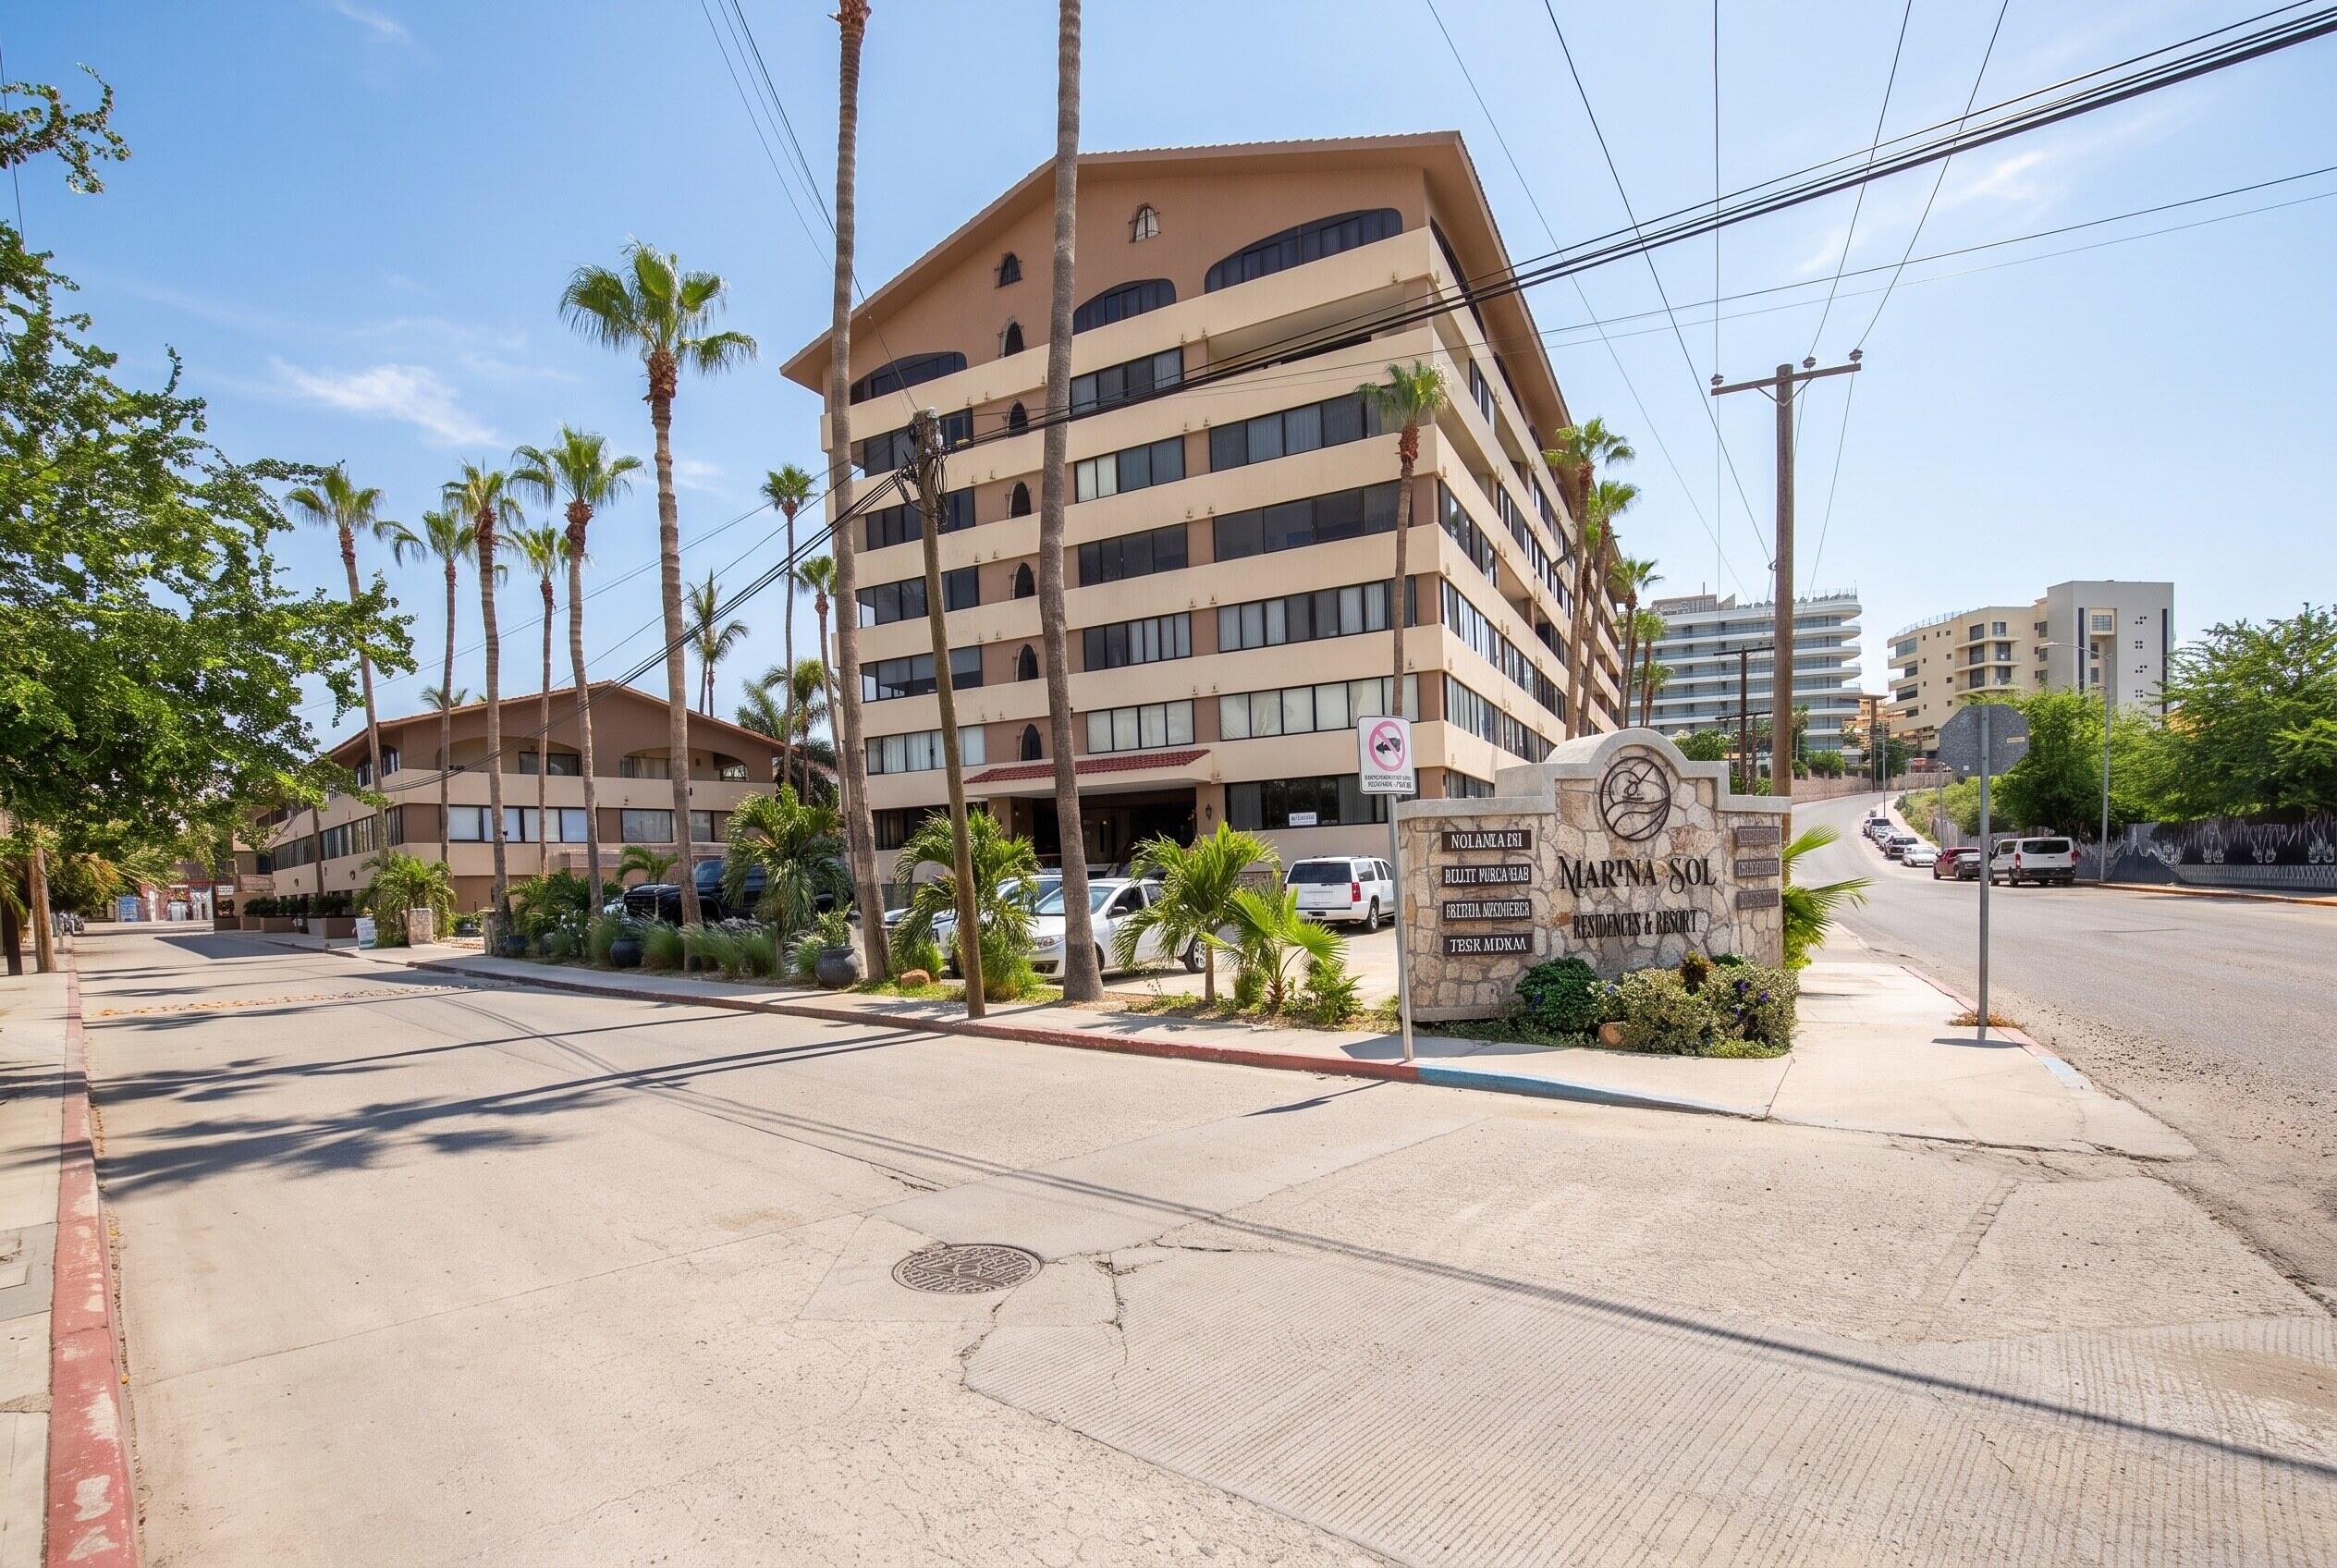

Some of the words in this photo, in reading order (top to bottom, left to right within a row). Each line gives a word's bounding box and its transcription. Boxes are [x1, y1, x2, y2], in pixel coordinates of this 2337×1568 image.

[1558, 855, 1658, 898] MARINA
[1669, 857, 1717, 894] SOL
[1573, 913, 1641, 939] RESIDENCES
[1645, 913, 1653, 935] &
[1656, 909, 1697, 935] RESORT
